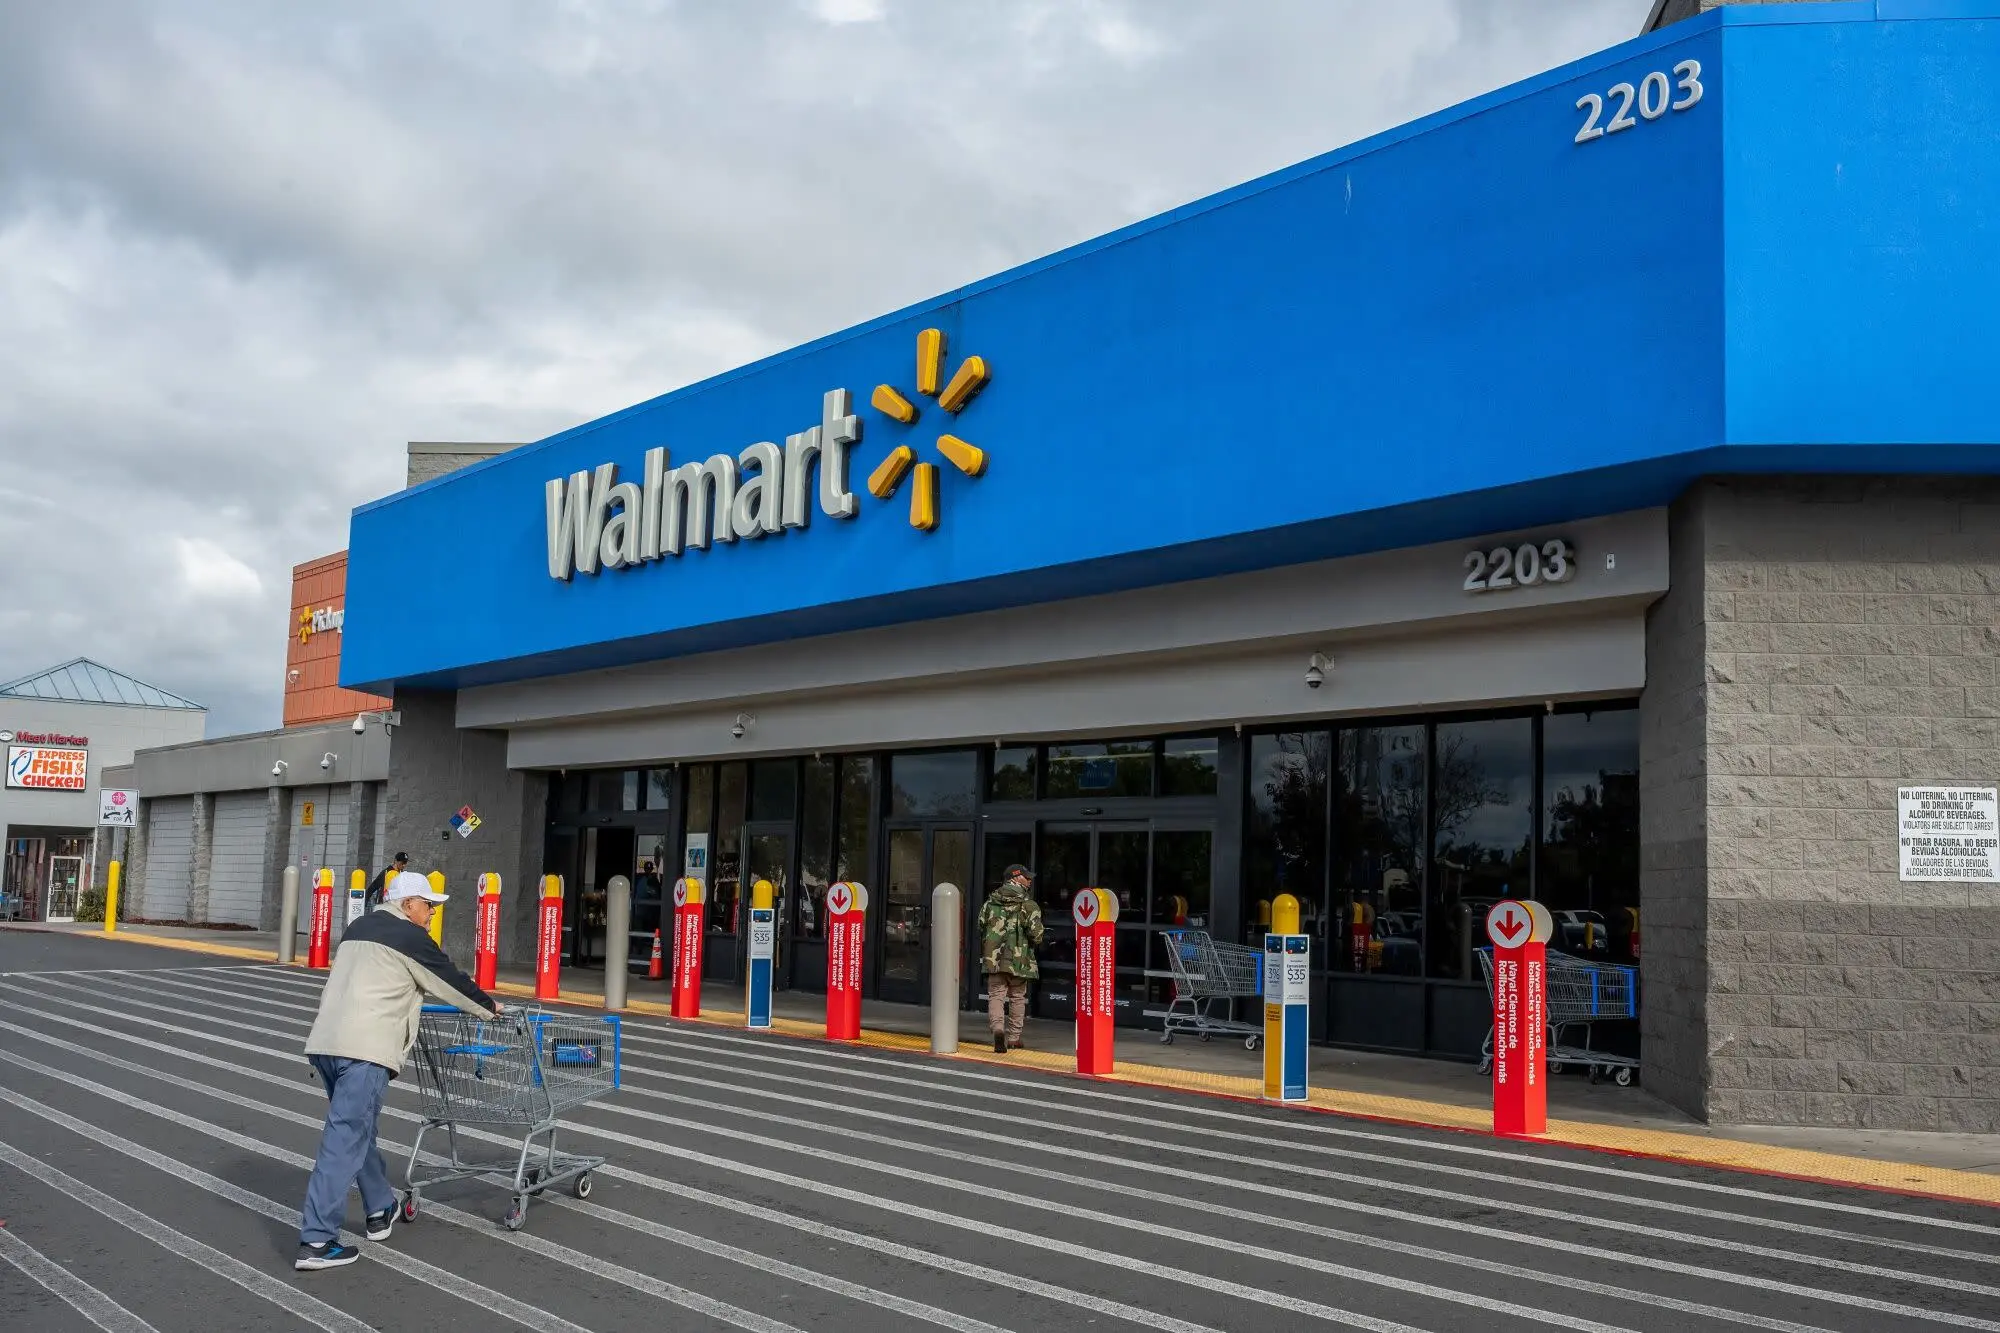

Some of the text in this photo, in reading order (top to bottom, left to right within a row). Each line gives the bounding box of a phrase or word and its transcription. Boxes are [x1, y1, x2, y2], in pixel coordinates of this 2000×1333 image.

[1575, 59, 1703, 144] 2203
[545, 387, 863, 582] Walmart
[1463, 538, 1573, 592] 2203
[38, 750, 85, 760] EXPRESS
[32, 759, 73, 775] FISH
[1900, 791, 1910, 800] NO
[1948, 792, 1958, 801] NO
[1920, 801, 1974, 810] NO DRINKING OF
[461, 807, 469, 818] 4
[1908, 810, 1945, 819] ALCOHOLIC
[470, 815, 477, 826] 2
[1903, 821, 1931, 830] VIOLATORS
[1931, 821, 1942, 830] ARE
[1942, 821, 1965, 831] SUBJECT
[1973, 822, 1994, 831] ARREST
[1901, 838, 1911, 847] NO
[1911, 838, 1932, 847] TIRAR
[1964, 839, 1974, 848] NO
[1975, 839, 1998, 849] BEBER
[1911, 847, 1940, 856] BEVIDAS
[1910, 858, 1945, 868] VIOLADORES
[755, 932, 770, 942] $35
[691, 958, 697, 967] de
[1287, 967, 1306, 981] $35
[838, 982, 843, 991] of
[855, 982, 859, 991] of
[1499, 960, 1507, 1011] Rollbacks
[1508, 960, 1518, 1048] ¡Vaya! Cientos de
[1086, 1006, 1092, 1016] of
[1105, 1006, 1111, 1017] of
[1528, 1014, 1534, 1022] y
[1499, 1021, 1507, 1059] mucho
[1535, 1034, 1541, 1048] de
[1499, 1061, 1507, 1084] más
